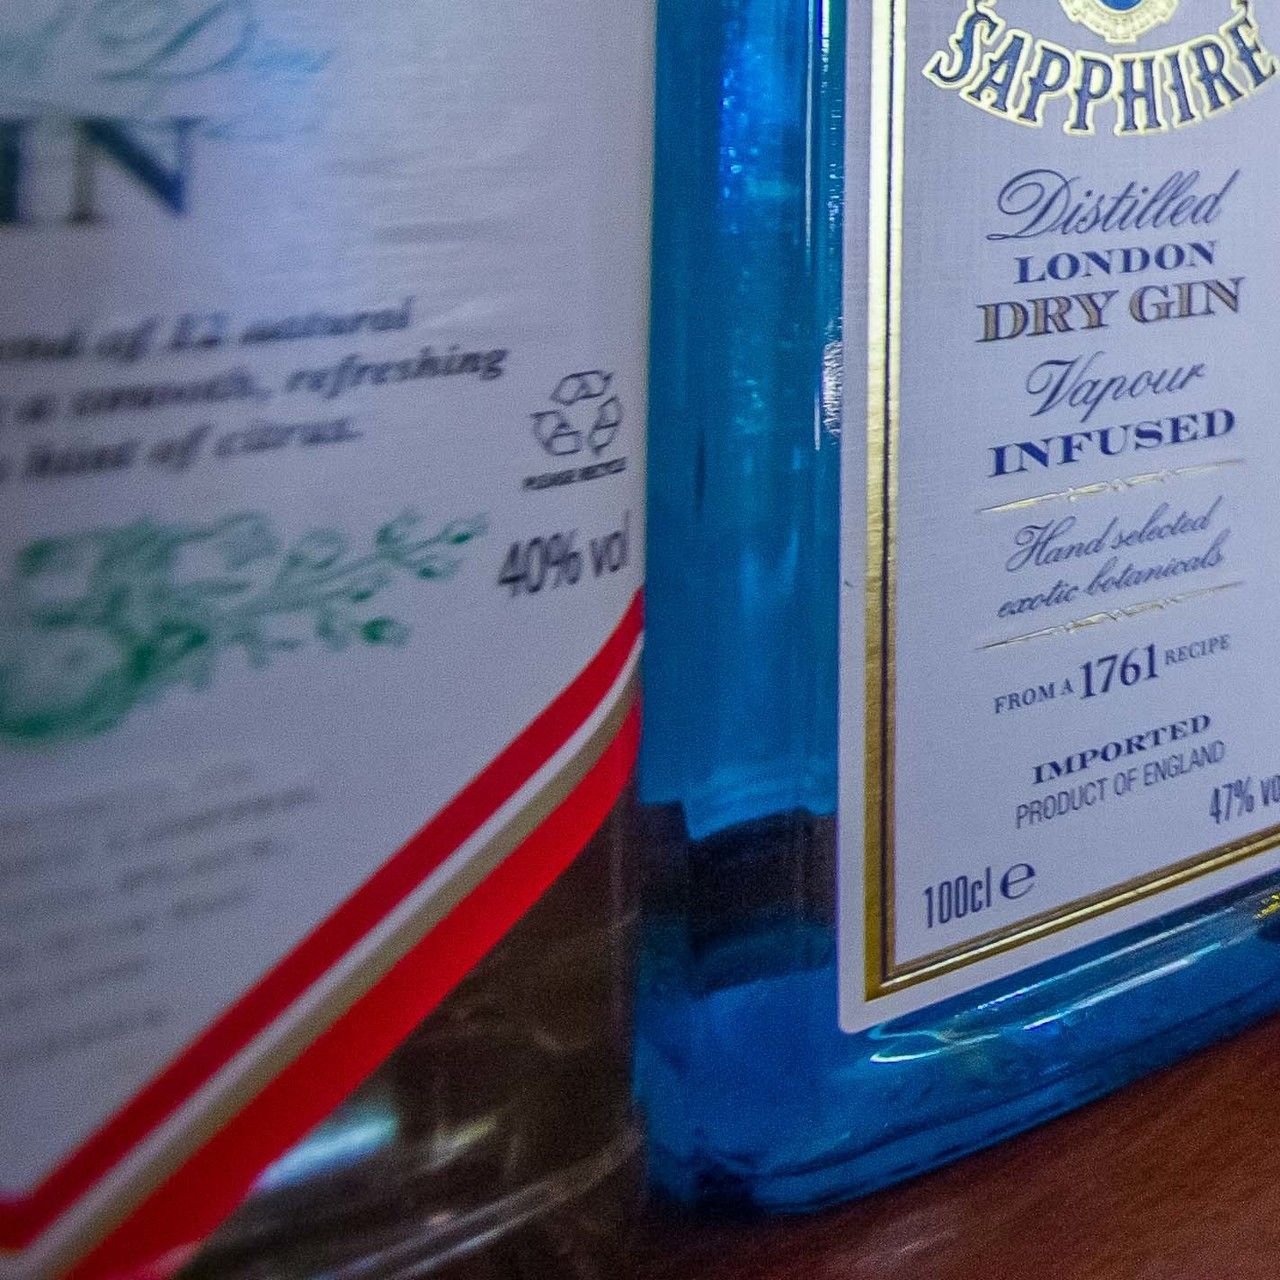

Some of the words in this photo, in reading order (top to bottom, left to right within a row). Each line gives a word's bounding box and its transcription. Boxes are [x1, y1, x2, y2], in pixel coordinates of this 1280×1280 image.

[986, 168, 1241, 241] Distilled
[1013, 240, 1218, 285] LONDON
[974, 289, 1120, 343] DRY
[1127, 276, 1246, 324] GIN
[286, 348, 511, 398] refreshing
[1025, 351, 1207, 424] Vapour
[987, 408, 1236, 479] INFUSED
[498, 528, 583, 598] 40%
[588, 507, 632, 578] vol
[1005, 516, 1114, 573] Hand
[1110, 496, 1223, 551] selected
[996, 577, 1078, 619] exotic
[1085, 527, 1232, 598] botanicals
[994, 683, 1059, 714] FROM
[1060, 679, 1076, 698] A
[1078, 643, 1160, 701] 1761
[1164, 633, 1231, 666] RECIPE
[1015, 778, 1109, 830] PRODUCT
[1113, 767, 1140, 797] OF
[1143, 740, 1226, 787] ENGLAND
[1031, 713, 1212, 785] IMPORTED
[1209, 774, 1255, 825] 47%
[924, 867, 993, 928] 100cl
